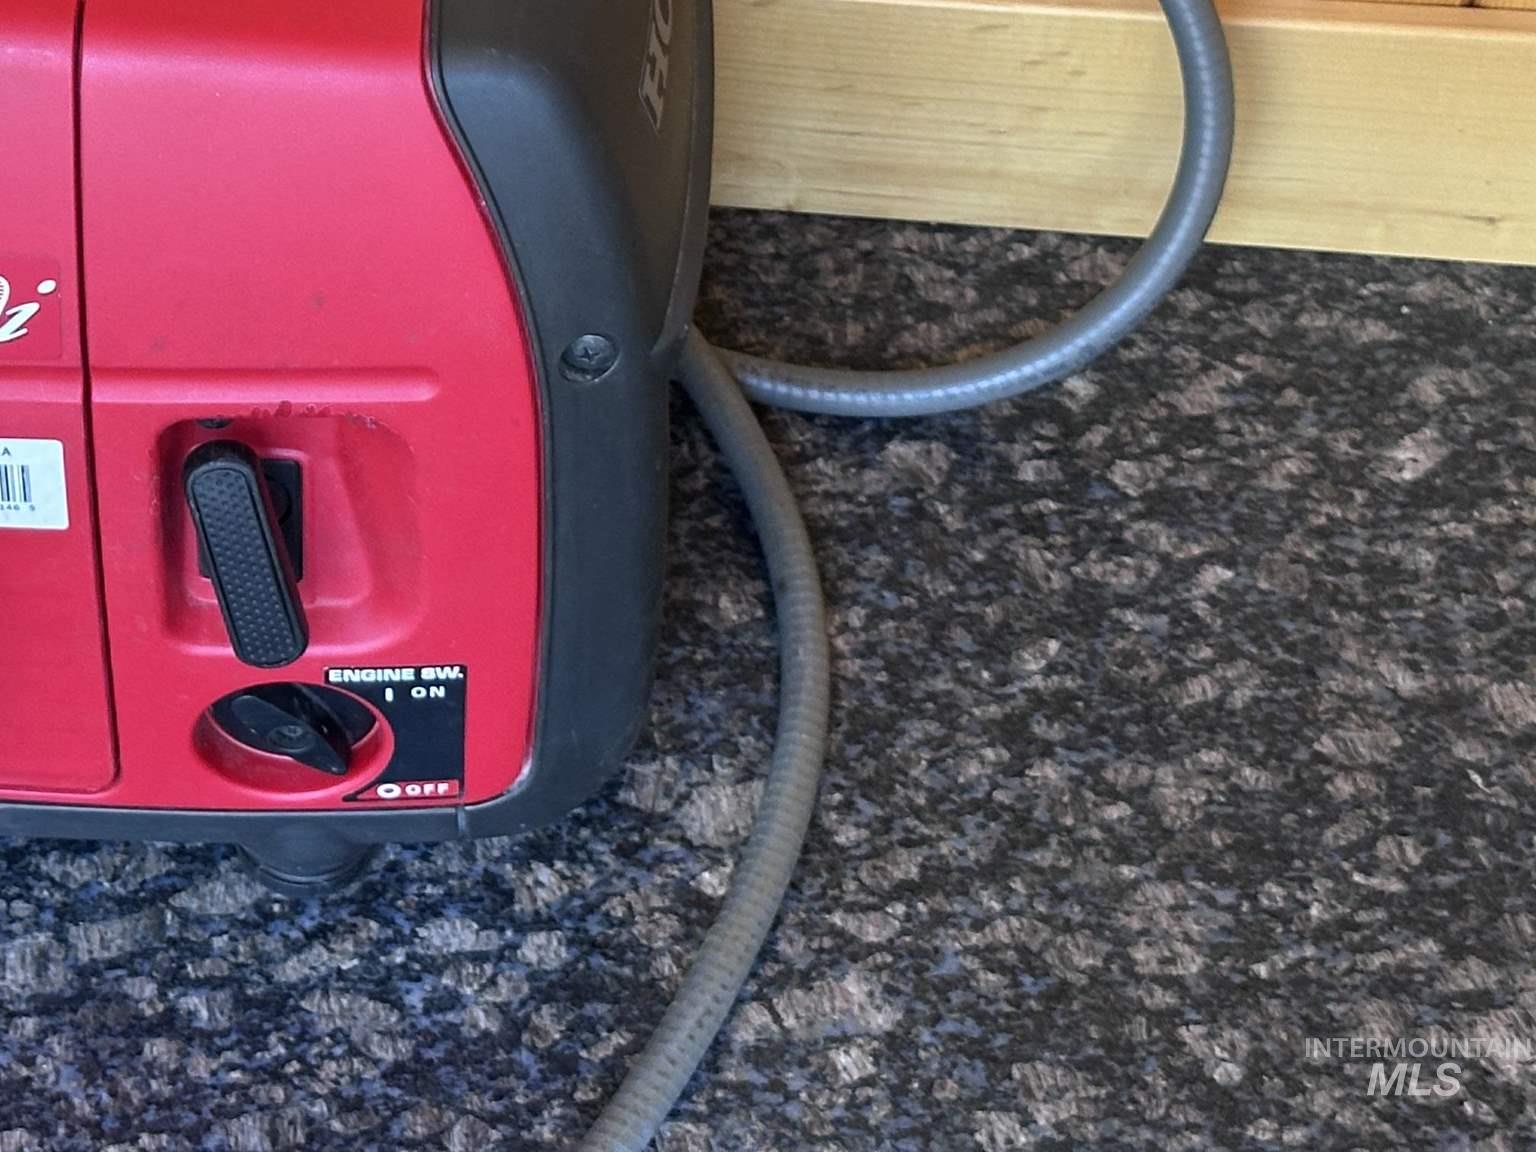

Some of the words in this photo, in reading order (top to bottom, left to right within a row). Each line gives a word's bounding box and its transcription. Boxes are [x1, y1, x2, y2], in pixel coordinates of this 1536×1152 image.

[328, 668, 415, 683] ENGINE
[420, 666, 464, 681] SW.
[410, 686, 446, 699] ON
[404, 782, 450, 797] OFF
